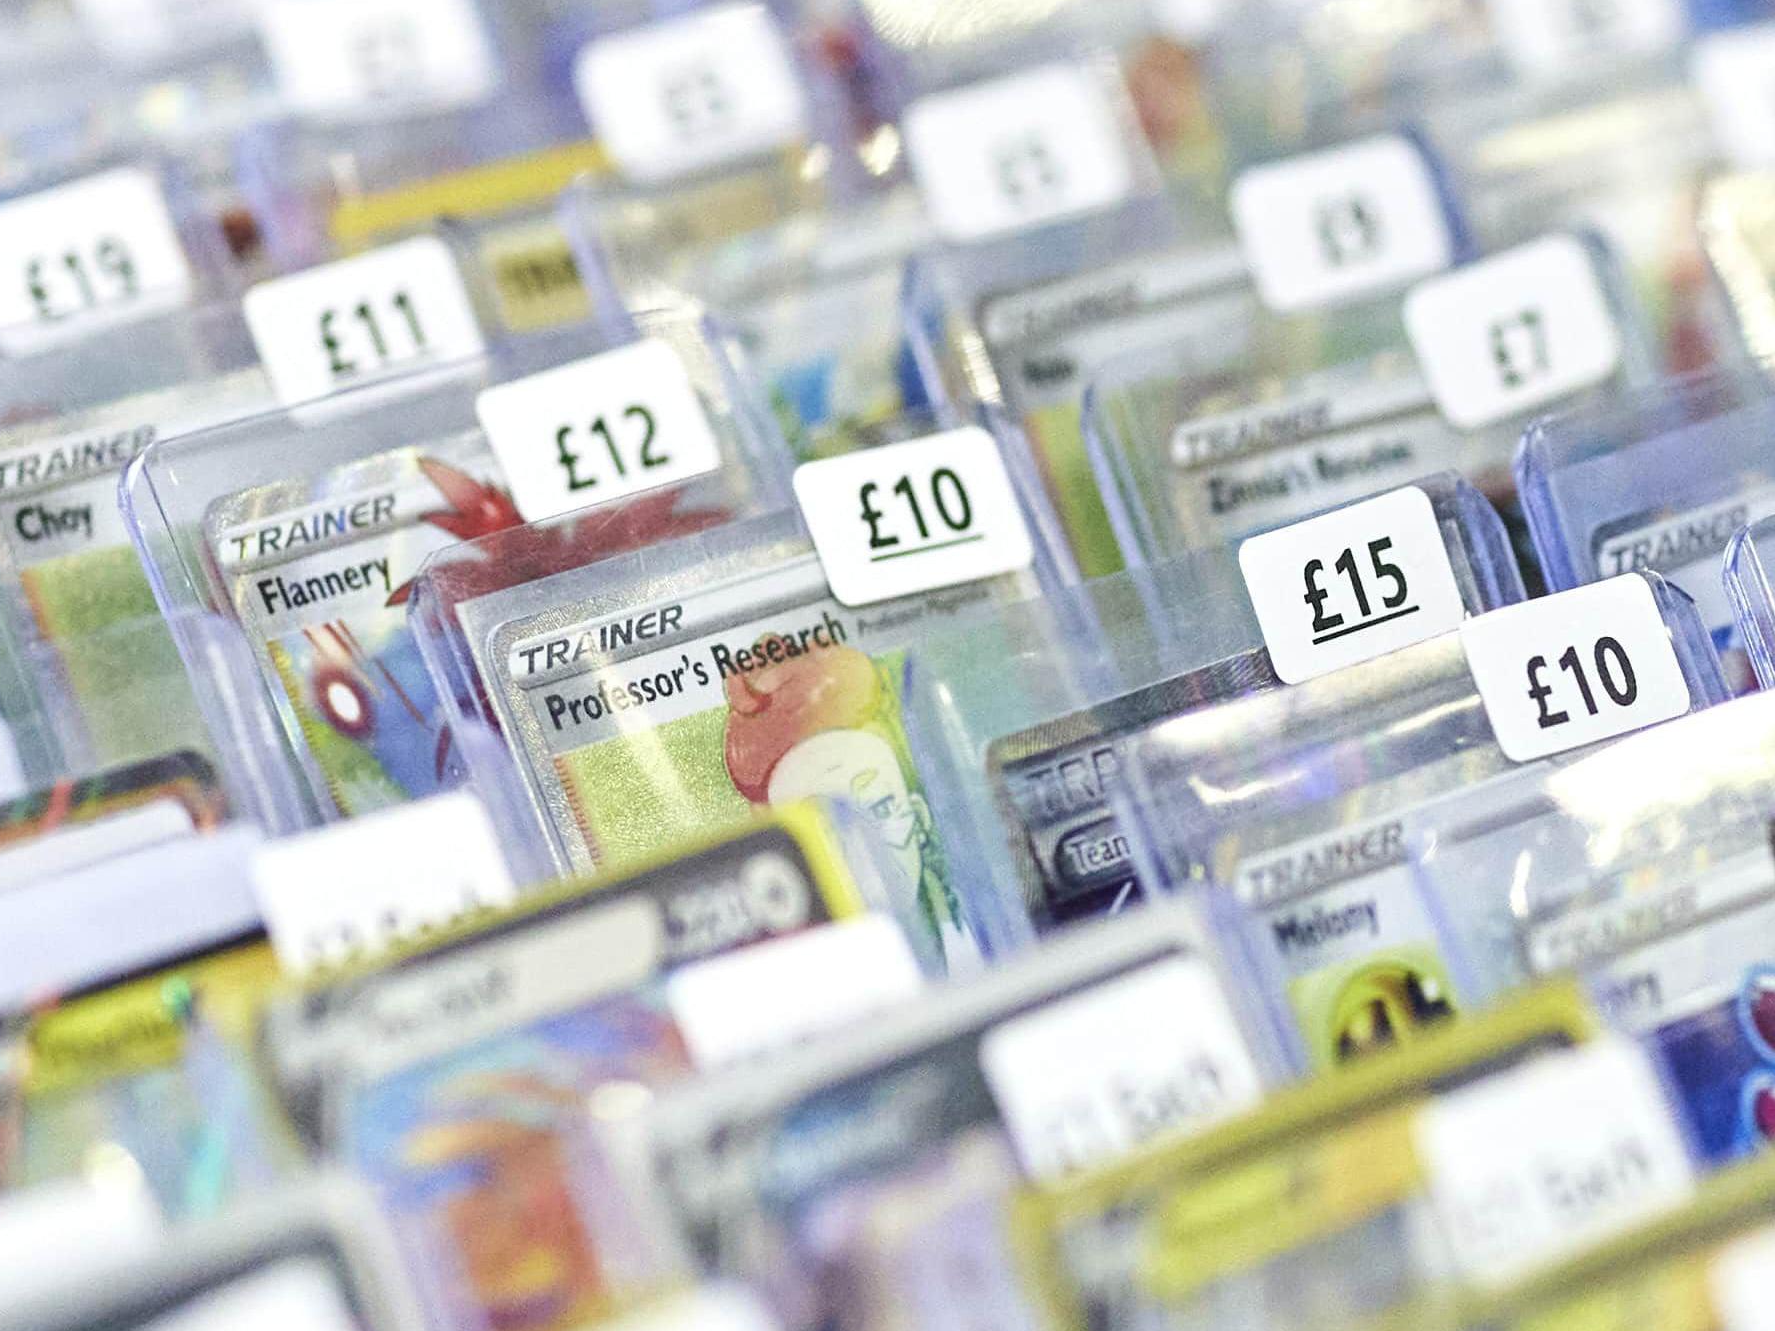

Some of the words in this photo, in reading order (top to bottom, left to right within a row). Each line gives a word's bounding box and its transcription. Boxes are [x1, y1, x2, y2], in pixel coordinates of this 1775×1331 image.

[318, 289, 427, 373] £11
[554, 403, 670, 493] £12
[229, 493, 398, 560] TRAINER
[859, 466, 975, 550] £10
[256, 555, 393, 617] Flannery
[1303, 535, 1409, 633] £15
[518, 603, 684, 675] TRAINER
[544, 657, 711, 731] Professor's
[711, 612, 848, 679] Research
[1526, 634, 1637, 730] £10
